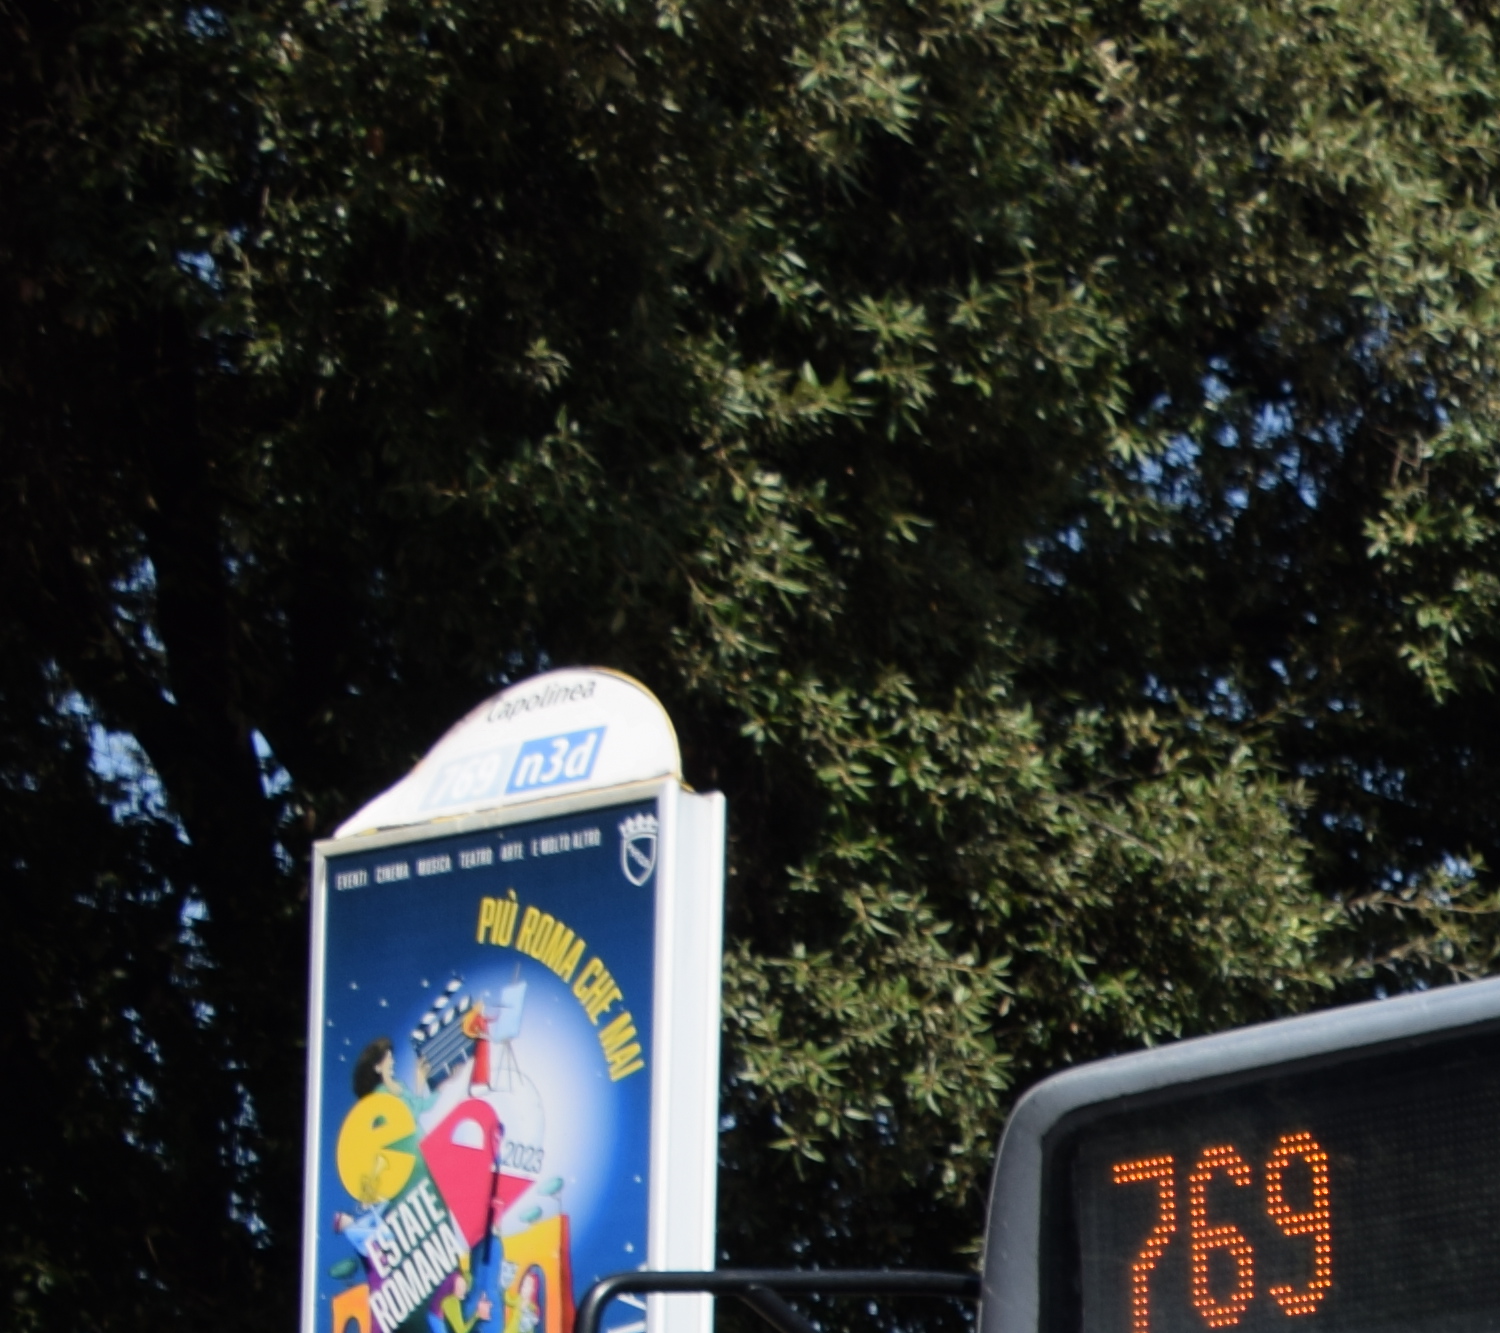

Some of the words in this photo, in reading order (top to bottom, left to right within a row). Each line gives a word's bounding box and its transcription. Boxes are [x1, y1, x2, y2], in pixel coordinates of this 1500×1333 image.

[487, 678, 597, 724] Capolinea
[514, 731, 598, 789] n3d
[335, 868, 368, 891] EVENTI
[374, 861, 410, 884] CINEMA
[415, 855, 451, 877] MUSICA
[458, 847, 493, 869] TEATRO
[500, 841, 524, 862] ARTE
[571, 827, 601, 849] ALTRO
[476, 888, 519, 947] PIÙ
[515, 905, 587, 984] ROMA
[572, 956, 623, 1026] CHE
[598, 1010, 645, 1083] MAI
[503, 1140, 545, 1174] 2023
[365, 1176, 446, 1279] ESTATE
